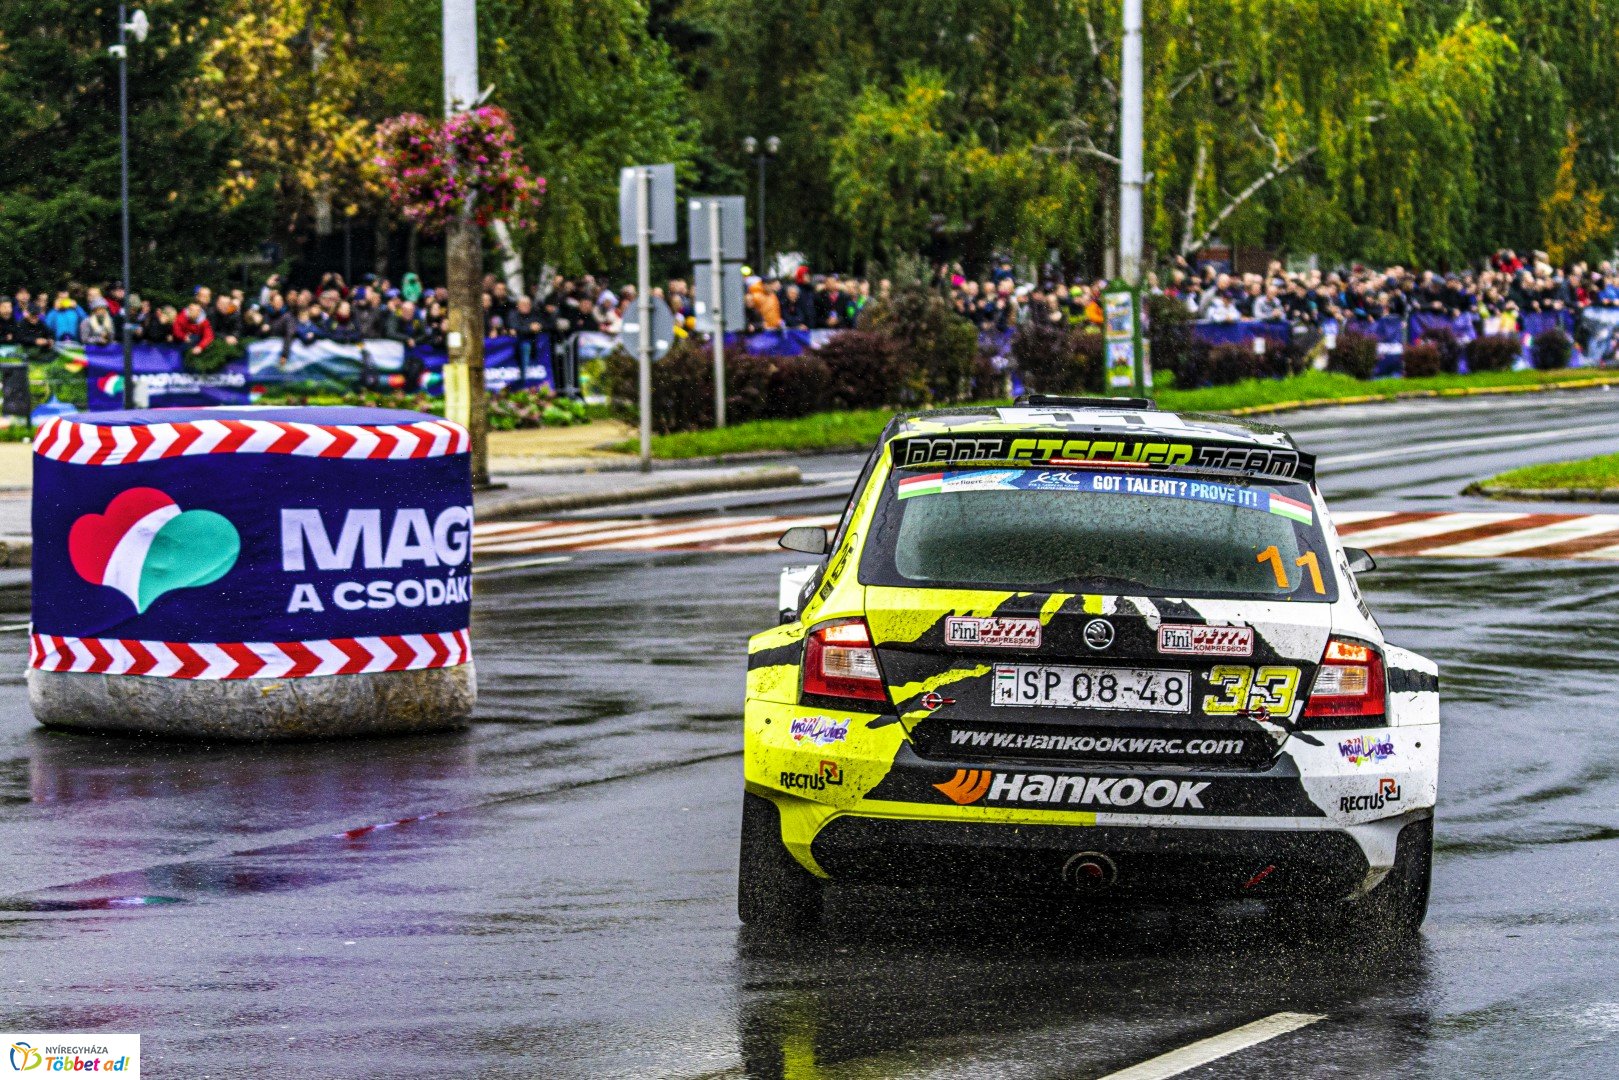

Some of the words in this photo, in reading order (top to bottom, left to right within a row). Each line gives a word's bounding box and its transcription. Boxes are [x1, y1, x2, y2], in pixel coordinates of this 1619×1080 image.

[1093, 475, 1122, 491] GOT
[1126, 476, 1188, 496] TALENT?
[1191, 482, 1236, 503] PROVE
[1238, 489, 1258, 507] IT!
[1256, 545, 1327, 595] 11
[287, 583, 325, 613] A
[333, 569, 470, 611] CSODÁK
[951, 622, 977, 640] Fini
[980, 636, 1036, 645] KOMPRESSOR
[1164, 631, 1190, 648] Fini
[1193, 645, 1248, 653] KOMPRESSOR
[1022, 671, 1062, 701] SP
[1072, 673, 1184, 706] 08-48
[1202, 665, 1302, 717] 33
